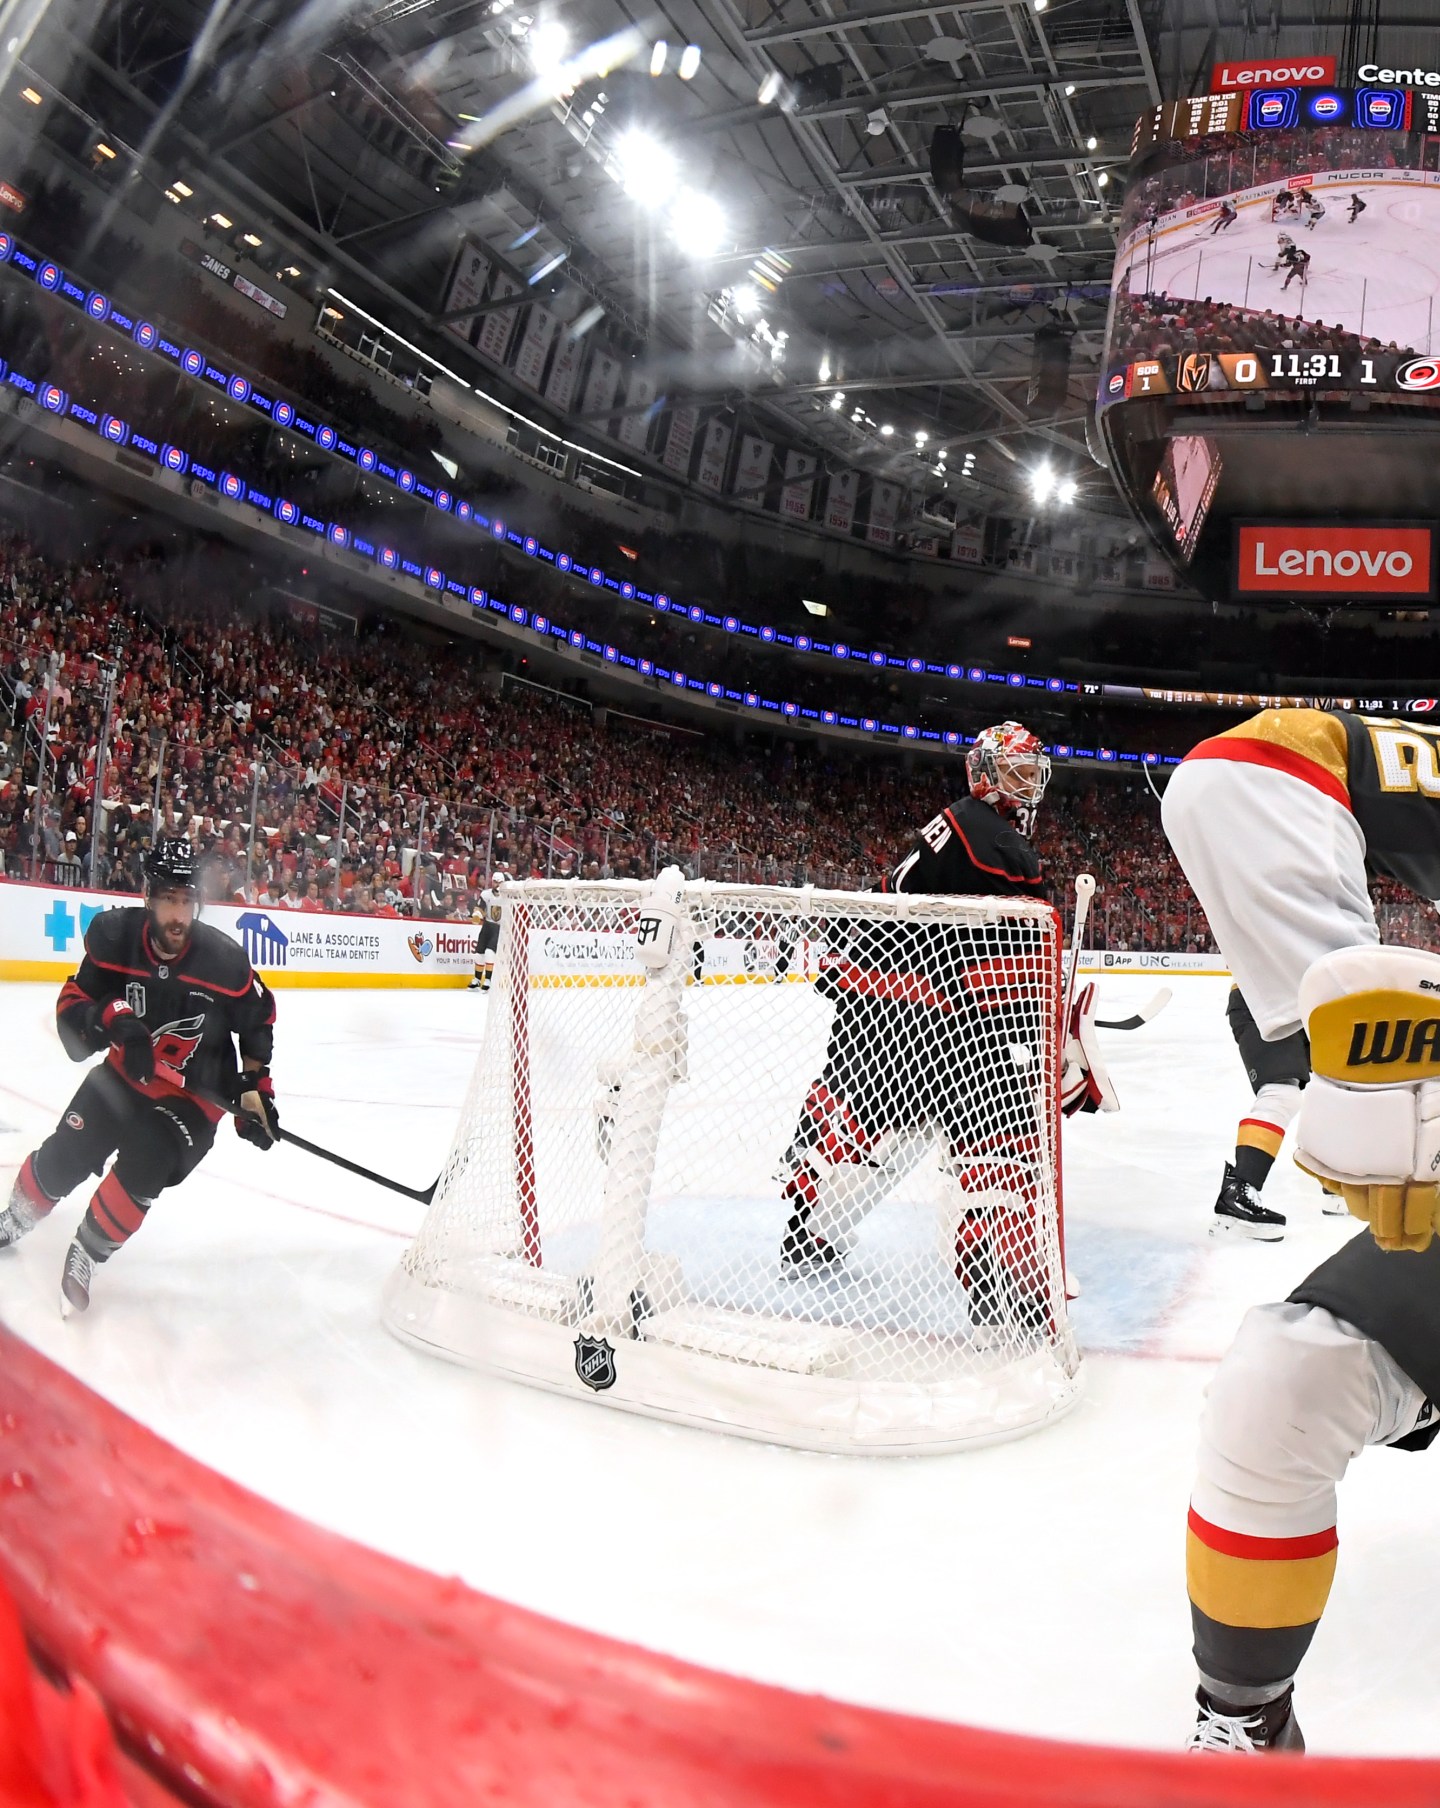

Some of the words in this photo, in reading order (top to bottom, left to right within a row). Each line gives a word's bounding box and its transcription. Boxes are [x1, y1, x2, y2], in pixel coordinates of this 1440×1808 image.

[1221, 65, 1325, 85] Lenovo
[1187, 96, 1207, 105] TIME
[1290, 177, 1311, 187] Lenovo
[1328, 172, 1384, 180] NUCOR
[200, 254, 231, 280] CANES
[14, 250, 36, 271] PEPSI
[62, 280, 84, 301] PEPSI
[112, 311, 133, 331] PEPSI
[159, 339, 180, 358] PEPSI
[205, 366, 227, 385] PEPSI
[252, 393, 272, 410] PEPSI
[296, 417, 316, 435] PEPSI
[1137, 365, 1159, 375] SOG
[1235, 359, 1257, 382] 0
[1271, 354, 1341, 377] 11:31
[1360, 360, 1377, 384] 1
[1141, 377, 1150, 390] 1
[1295, 378, 1317, 386] FIRST
[9, 372, 36, 393] PEPSI
[71, 403, 98, 425] PEPSI
[132, 433, 158, 455] PEPSI
[192, 463, 216, 483] PEPSI
[249, 490, 272, 509] PEPSI
[302, 514, 324, 533] PEPSI
[354, 538, 374, 555] PEPSI
[402, 560, 422, 576] PEPSI
[880, 722, 900, 734] PEPSI
[1119, 751, 1139, 762] PEPSI
[1255, 542, 1413, 577] Lenovo
[1009, 638, 1030, 646] Lenovo
[290, 931, 313, 944] LANE
[316, 933, 322, 944] &
[324, 934, 380, 947] ASSOCIATES
[290, 947, 324, 958] OFFICIAL
[326, 948, 347, 959] TEAM
[349, 950, 380, 960] DENTIST
[1140, 955, 1170, 967] UNC
[584, 1353, 605, 1375] NHL
